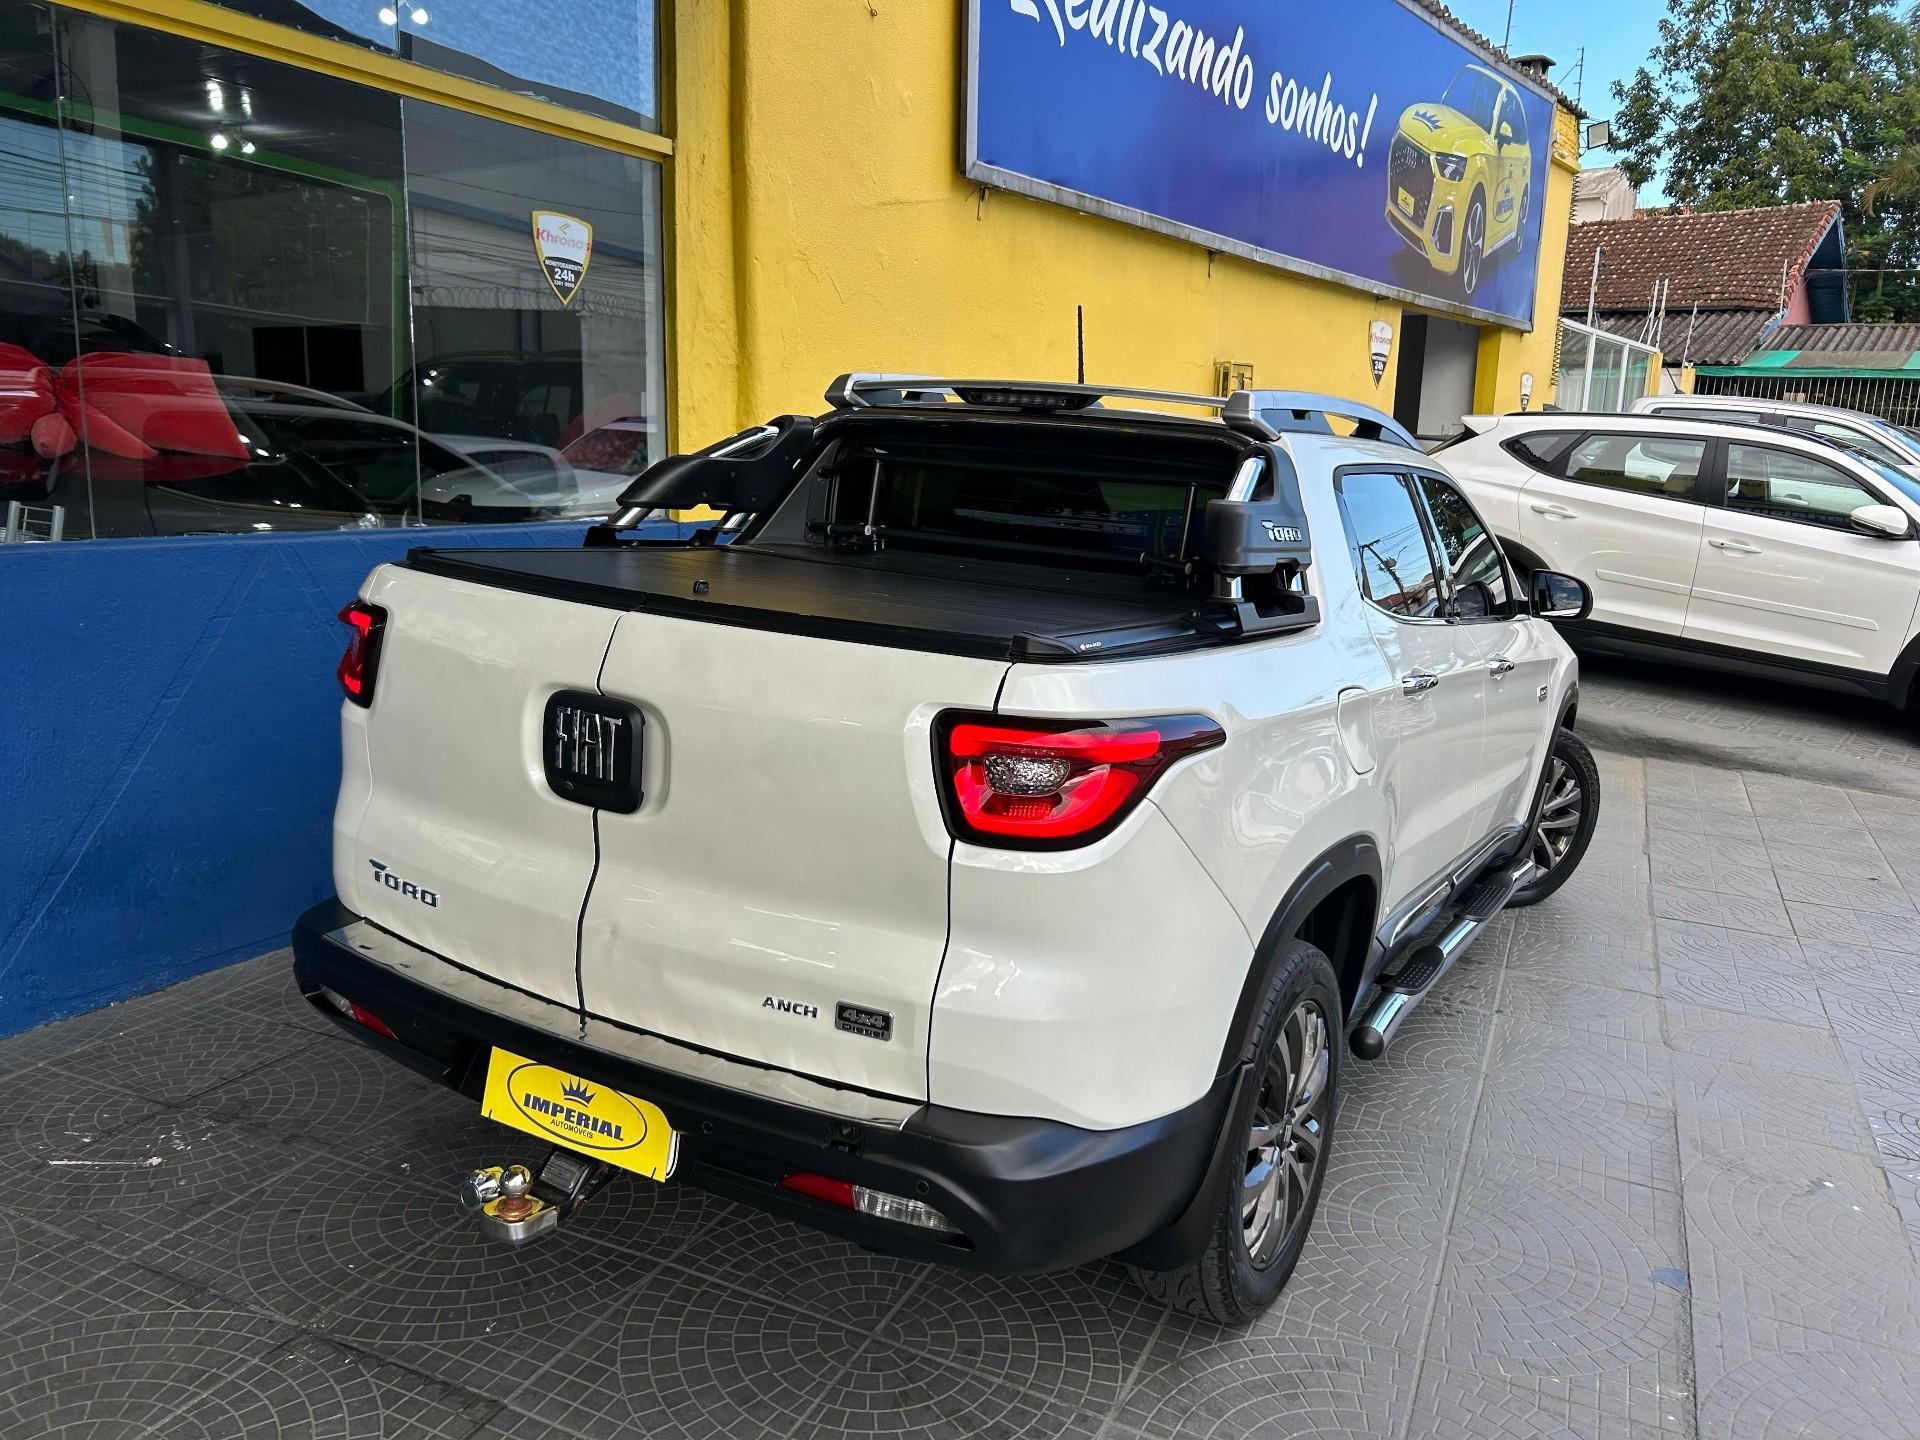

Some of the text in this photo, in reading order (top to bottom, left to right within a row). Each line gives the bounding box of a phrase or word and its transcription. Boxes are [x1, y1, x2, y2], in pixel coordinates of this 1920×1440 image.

[1265, 72, 1378, 168] sonhos!
[536, 227, 591, 252] Khronos
[554, 268, 575, 282] 24h
[1261, 520, 1303, 541] TORO
[555, 706, 623, 781] FIAT
[368, 859, 440, 908] TORO
[762, 996, 820, 1018] ANCH
[842, 1008, 886, 1029] 4x4
[523, 1092, 624, 1142] IMPERIAL
